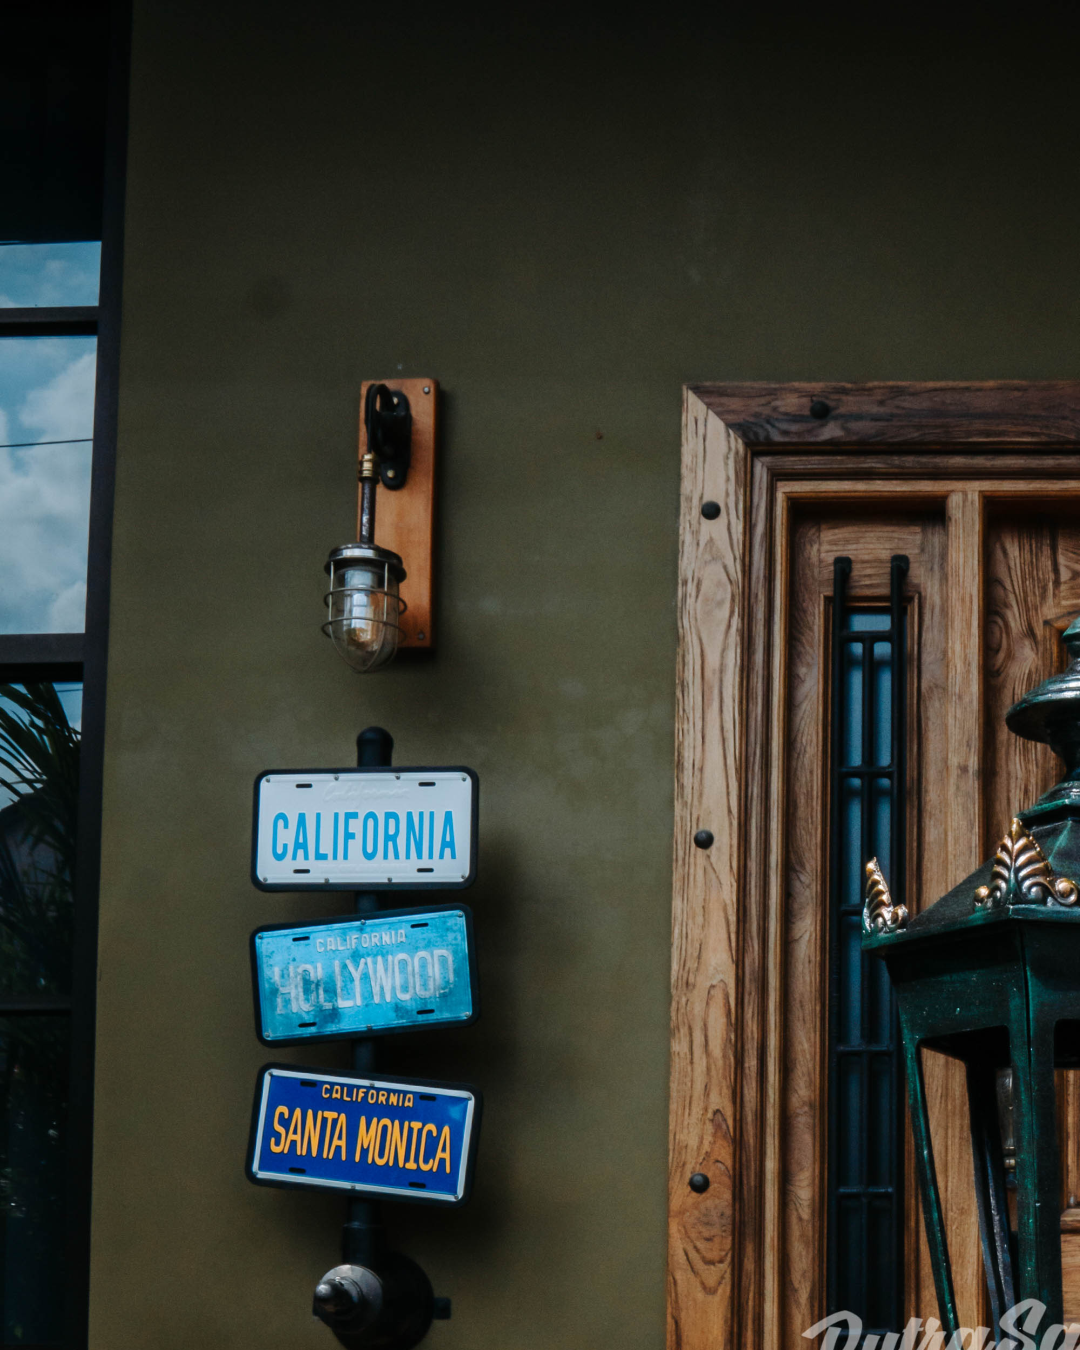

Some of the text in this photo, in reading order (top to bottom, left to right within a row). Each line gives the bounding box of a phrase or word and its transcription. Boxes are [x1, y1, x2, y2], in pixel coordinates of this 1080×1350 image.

[272, 811, 457, 862] CALIFORNIA
[316, 929, 407, 953] CALIFORNIA
[274, 949, 455, 1015] HOLLYWOOD
[321, 1084, 414, 1108] CALIFORNIA
[270, 1105, 451, 1174] SANTA MONICA
